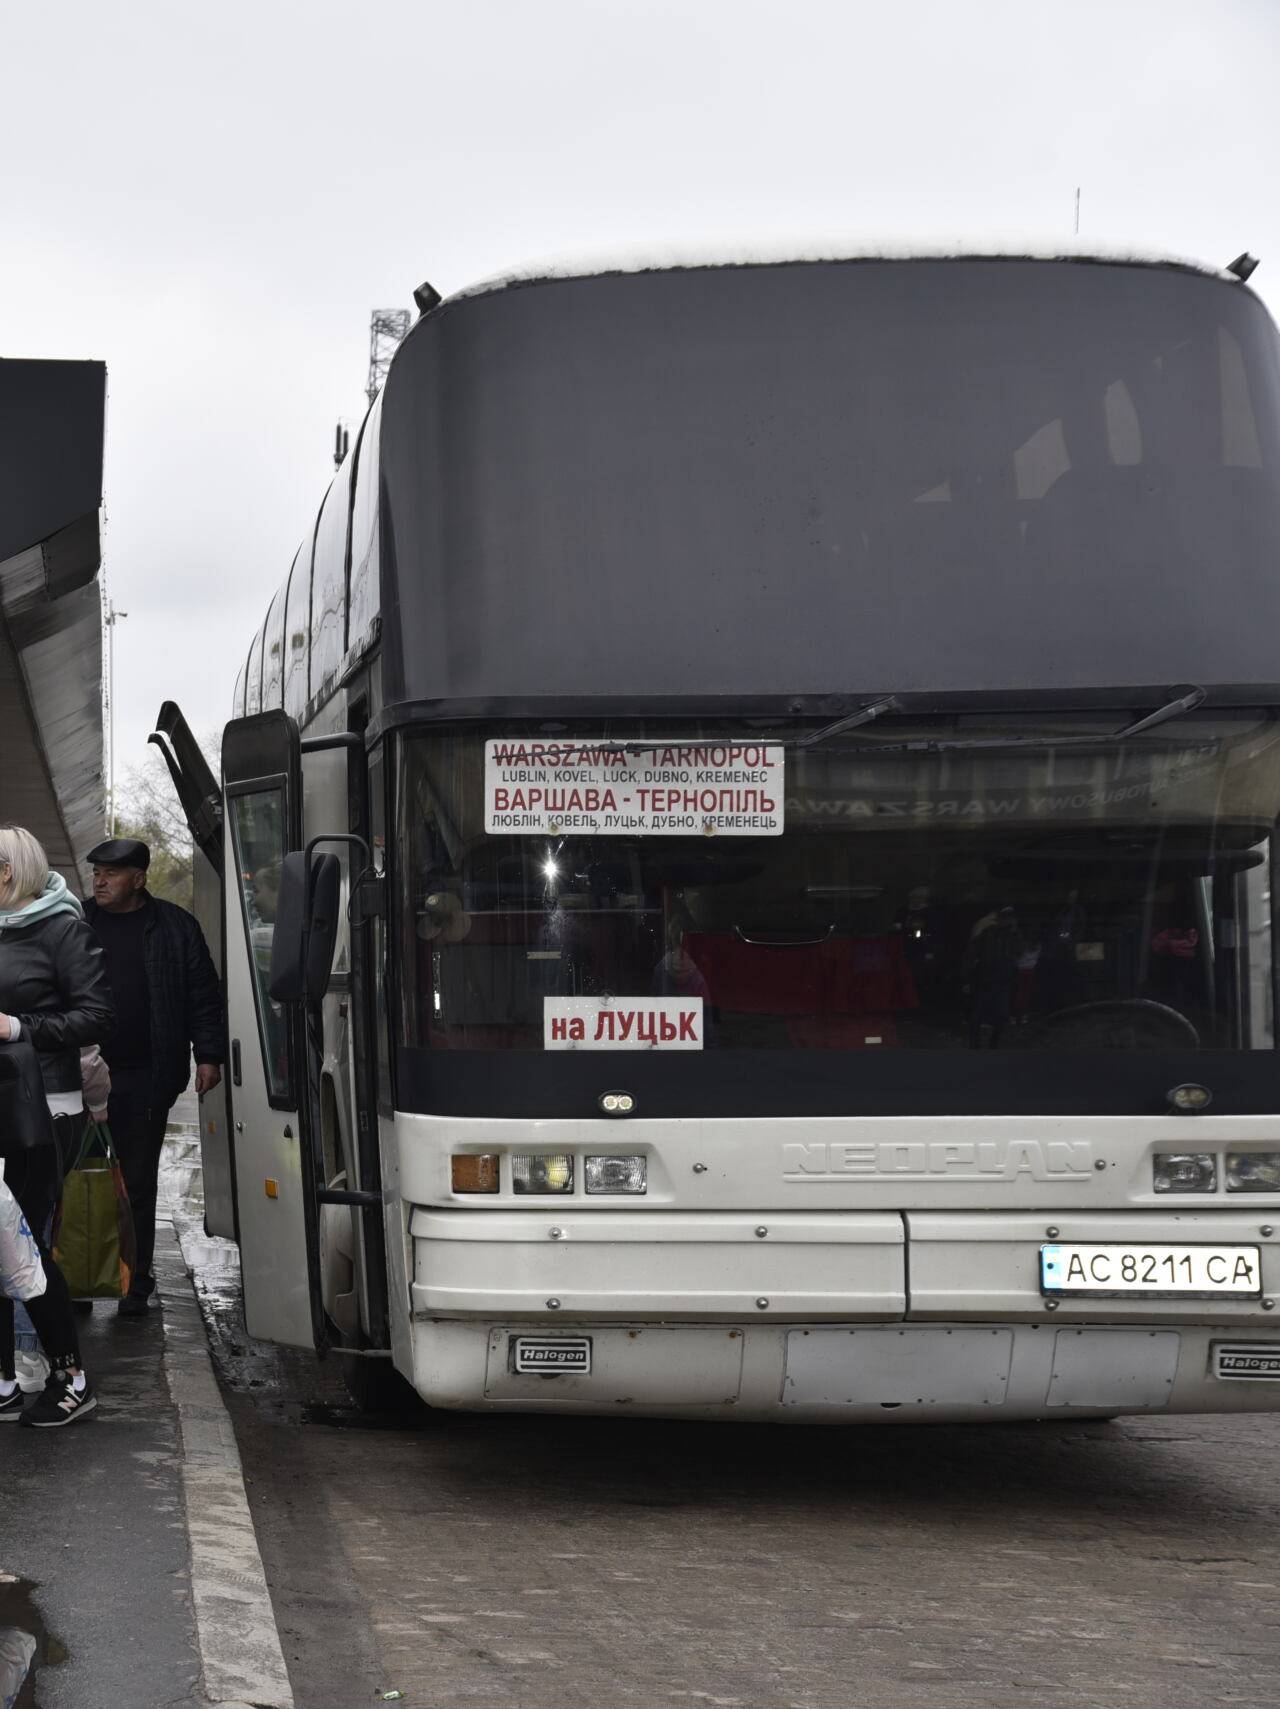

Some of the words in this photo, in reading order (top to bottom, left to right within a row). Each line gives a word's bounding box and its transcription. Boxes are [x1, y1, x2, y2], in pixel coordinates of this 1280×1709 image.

[493, 744, 627, 767] WARSZAWA
[501, 769, 550, 785] LUBLIN,
[553, 769, 598, 785] KOVEL,
[602, 770, 642, 785] LUCK,
[644, 770, 695, 786] DUBNO,
[696, 770, 768, 784] KREMENEC
[494, 788, 617, 812] ВАРШАВА
[636, 789, 775, 814] ТЕРНОПІЛЬ
[492, 814, 544, 828] ЛЮБЛІН,
[548, 814, 601, 828] КОВЕЛЬ,
[604, 815, 648, 829] ЛУЦЬК,
[651, 815, 698, 829] ДУБНО,
[701, 815, 777, 830] КРЕМЕНЕЦЬ
[551, 1017, 585, 1041] на
[593, 1011, 698, 1046] ЛУЦЬК
[782, 1140, 1092, 1182] NEOPLAN
[1066, 1253, 1111, 1282] AC
[1121, 1254, 1193, 1284] 8211
[1206, 1255, 1254, 1285] CA
[523, 1349, 584, 1362] Halogen
[1222, 1357, 1280, 1370] Haloge
